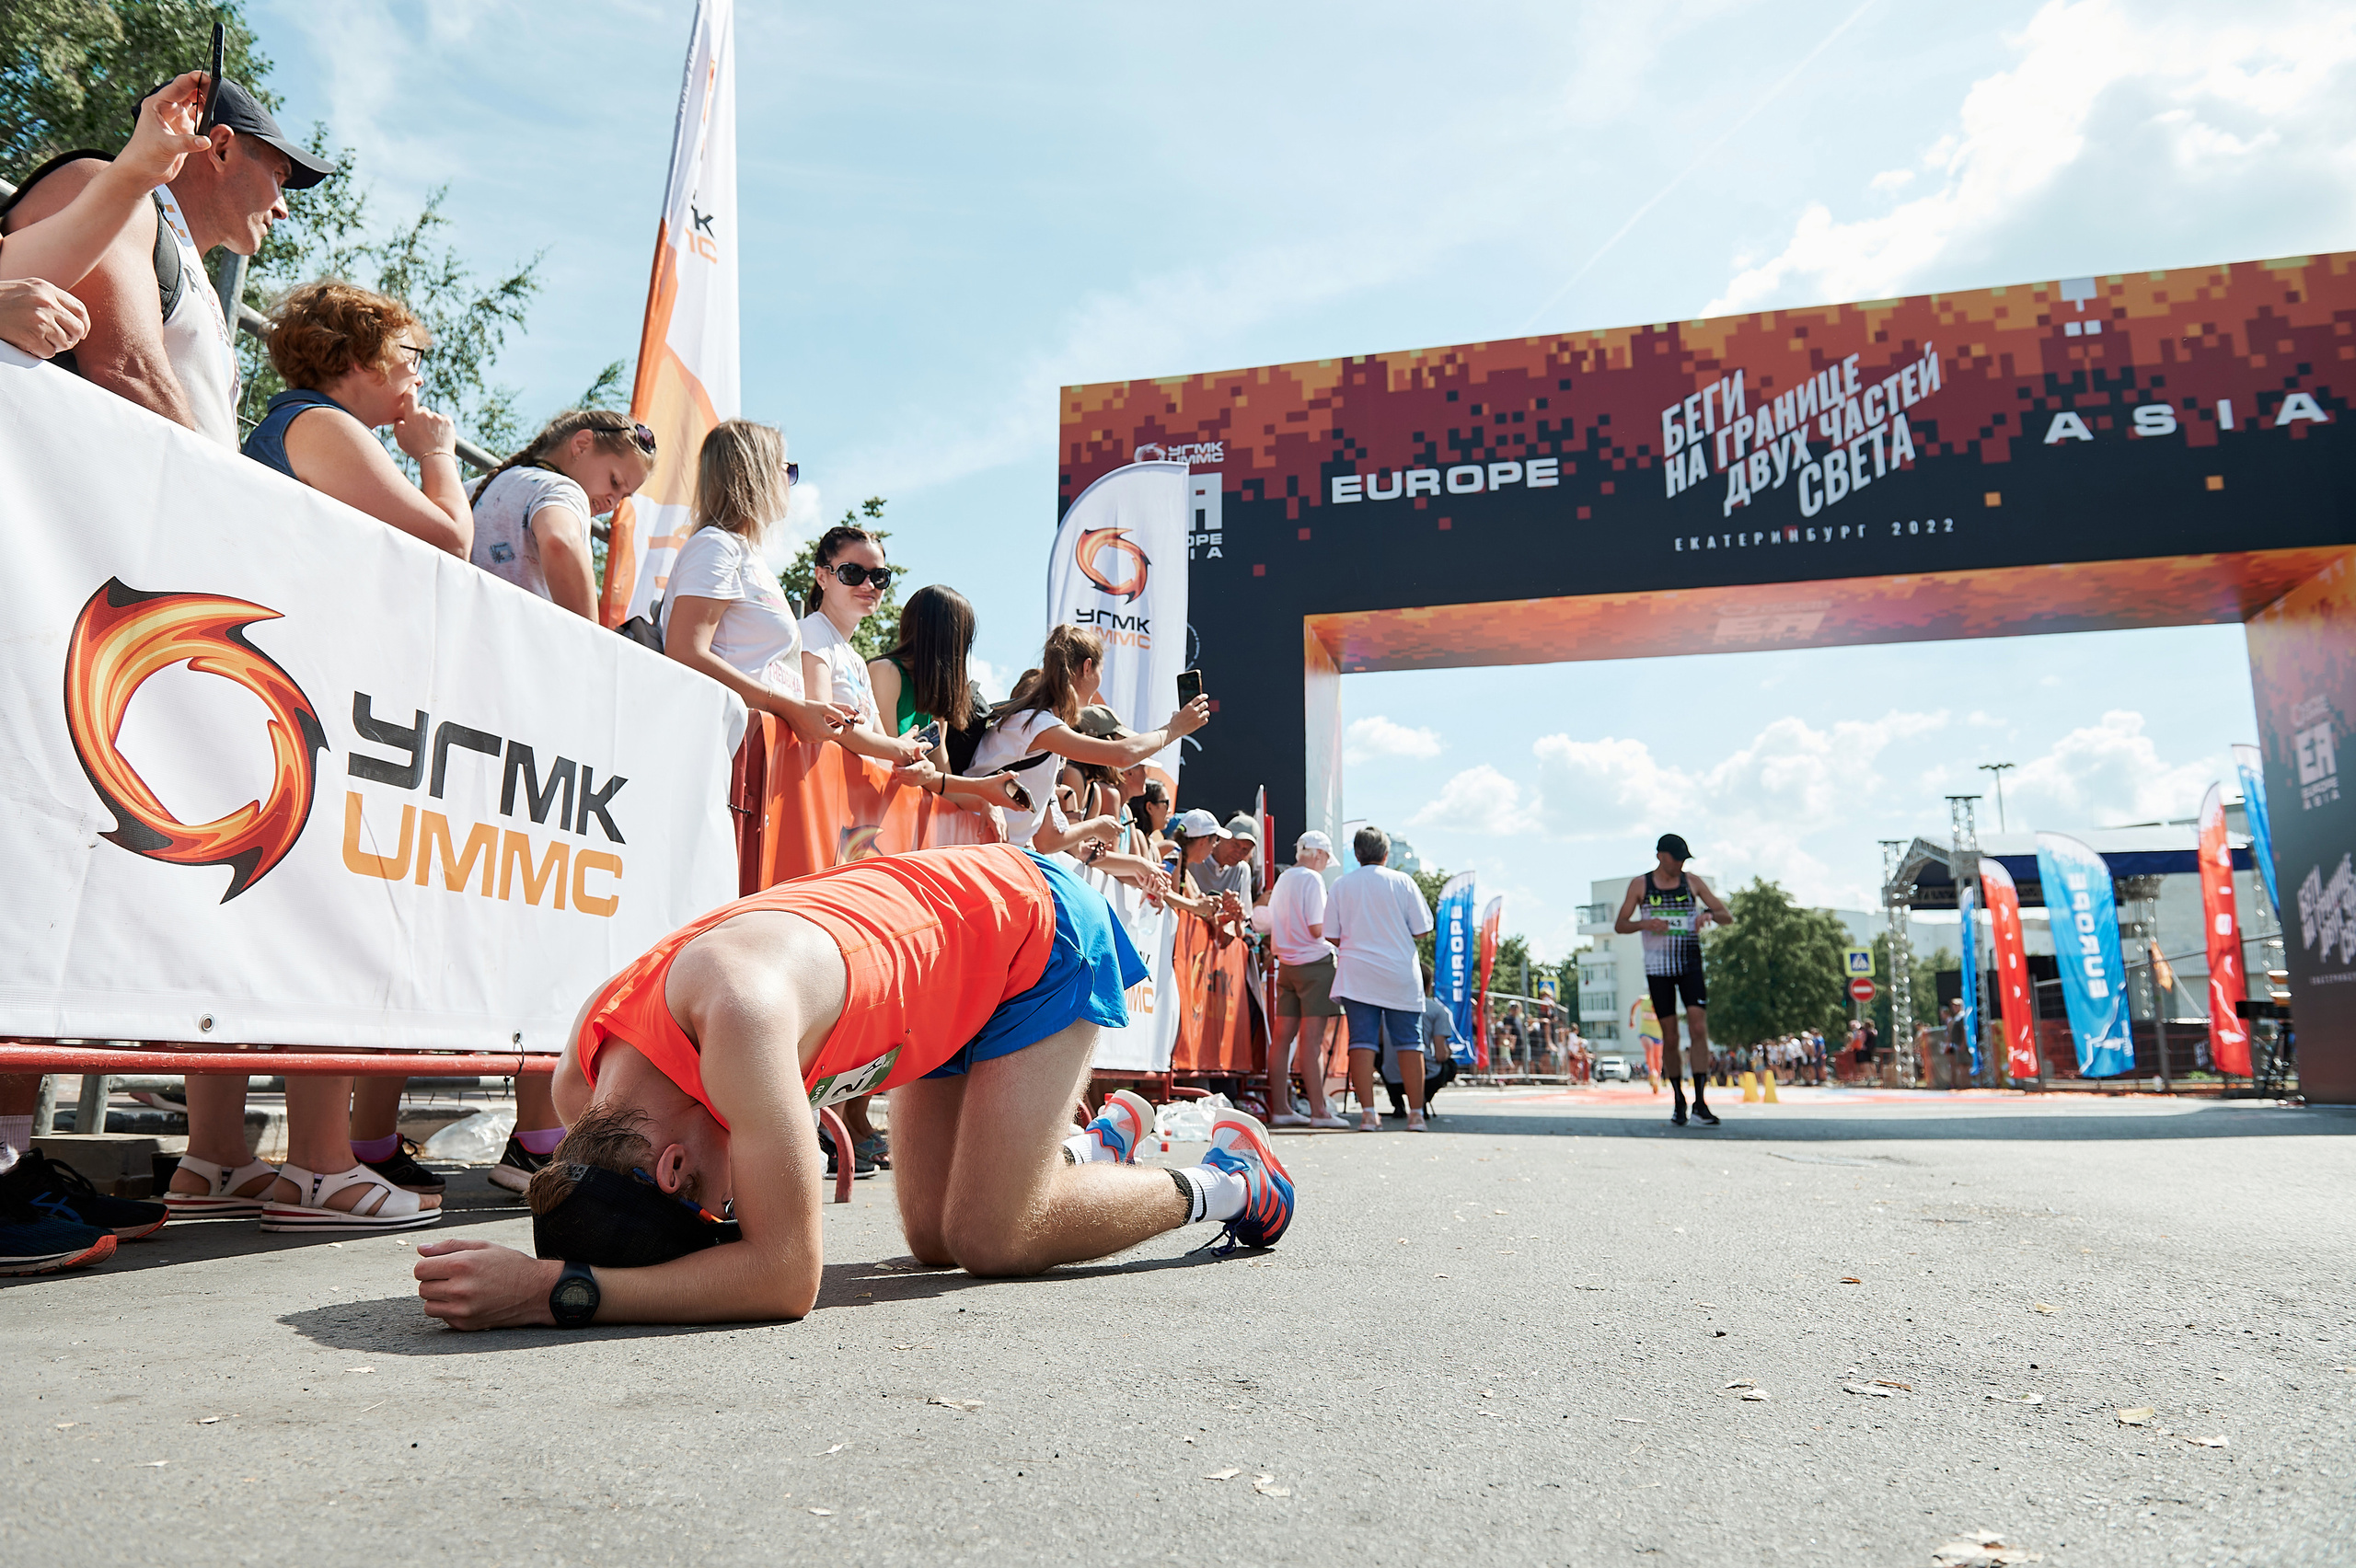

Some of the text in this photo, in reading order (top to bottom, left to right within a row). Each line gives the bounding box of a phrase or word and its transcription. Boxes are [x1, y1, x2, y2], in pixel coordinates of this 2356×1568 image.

[1168, 441, 1224, 456] УГМК
[1661, 368, 1747, 458] БЕГИ
[1664, 352, 1863, 499] НА ГРАНИЦЕ
[1723, 340, 1942, 518] ДВУХ ЧАСТЕЙ
[2042, 392, 2329, 444] ASIA
[1331, 457, 1560, 505] EUROPE
[1797, 412, 1916, 518] СВЕТА
[1674, 517, 1955, 552] ЕКАТЕРИНБУРГ 2022
[1076, 608, 1150, 635] УГМК
[348, 690, 629, 845] УГМК
[342, 791, 623, 918] UMMC
[1449, 905, 1465, 1002] EUROPE
